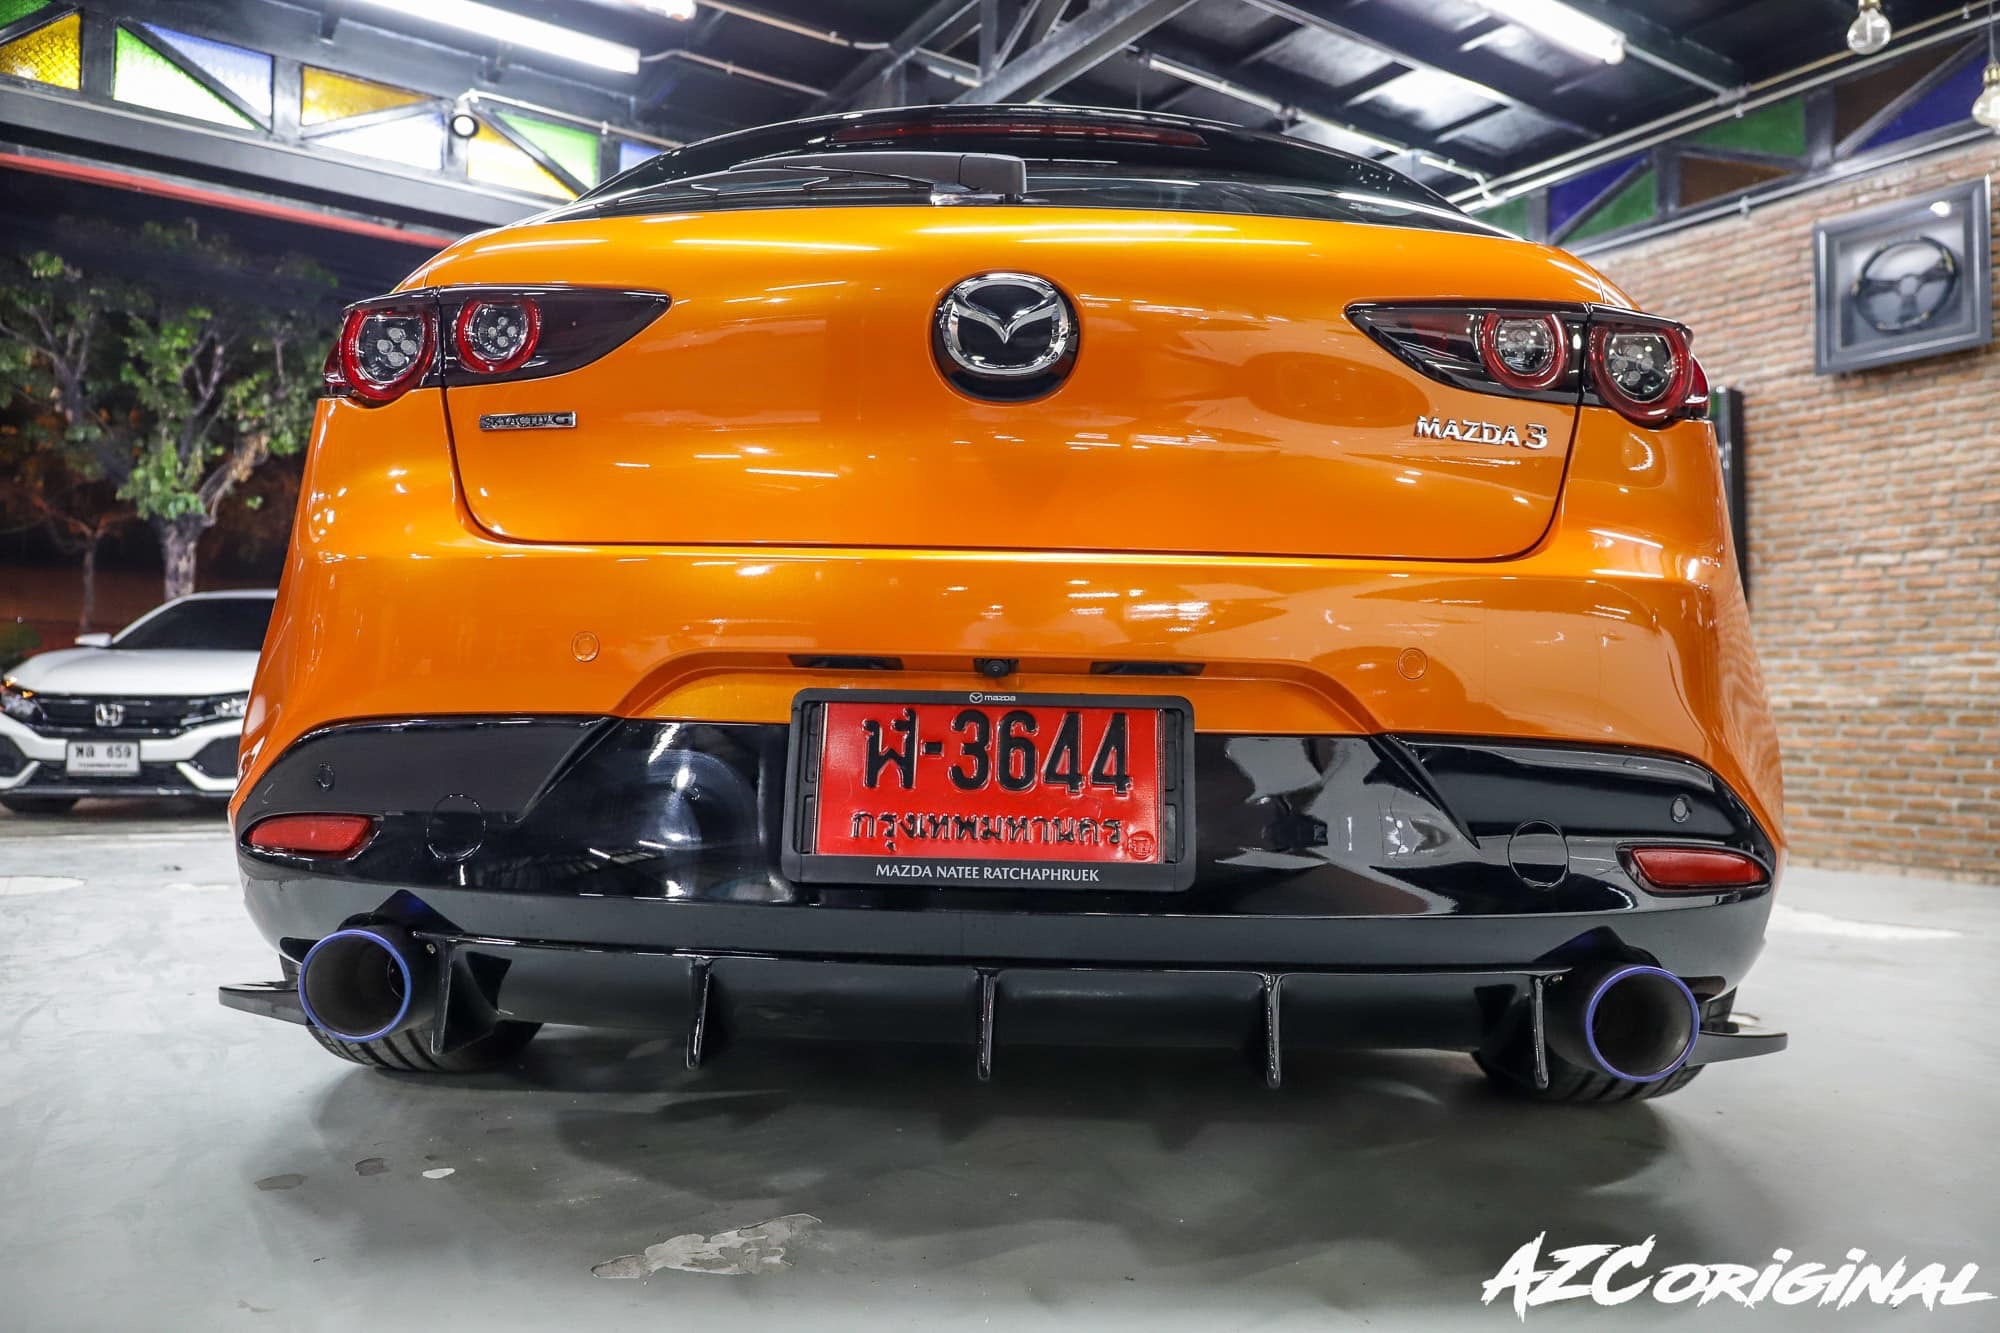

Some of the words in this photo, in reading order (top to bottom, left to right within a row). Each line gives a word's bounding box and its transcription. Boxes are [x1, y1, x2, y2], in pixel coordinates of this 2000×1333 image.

[1414, 415, 1520, 447] MAZDA
[1523, 423, 1549, 450] 3
[851, 811, 1122, 851] กรุงเทพมหานคร
[876, 864, 933, 878] MAZDA
[936, 866, 980, 880] NATEE
[983, 866, 1100, 882] RATCHAPHRUEK
